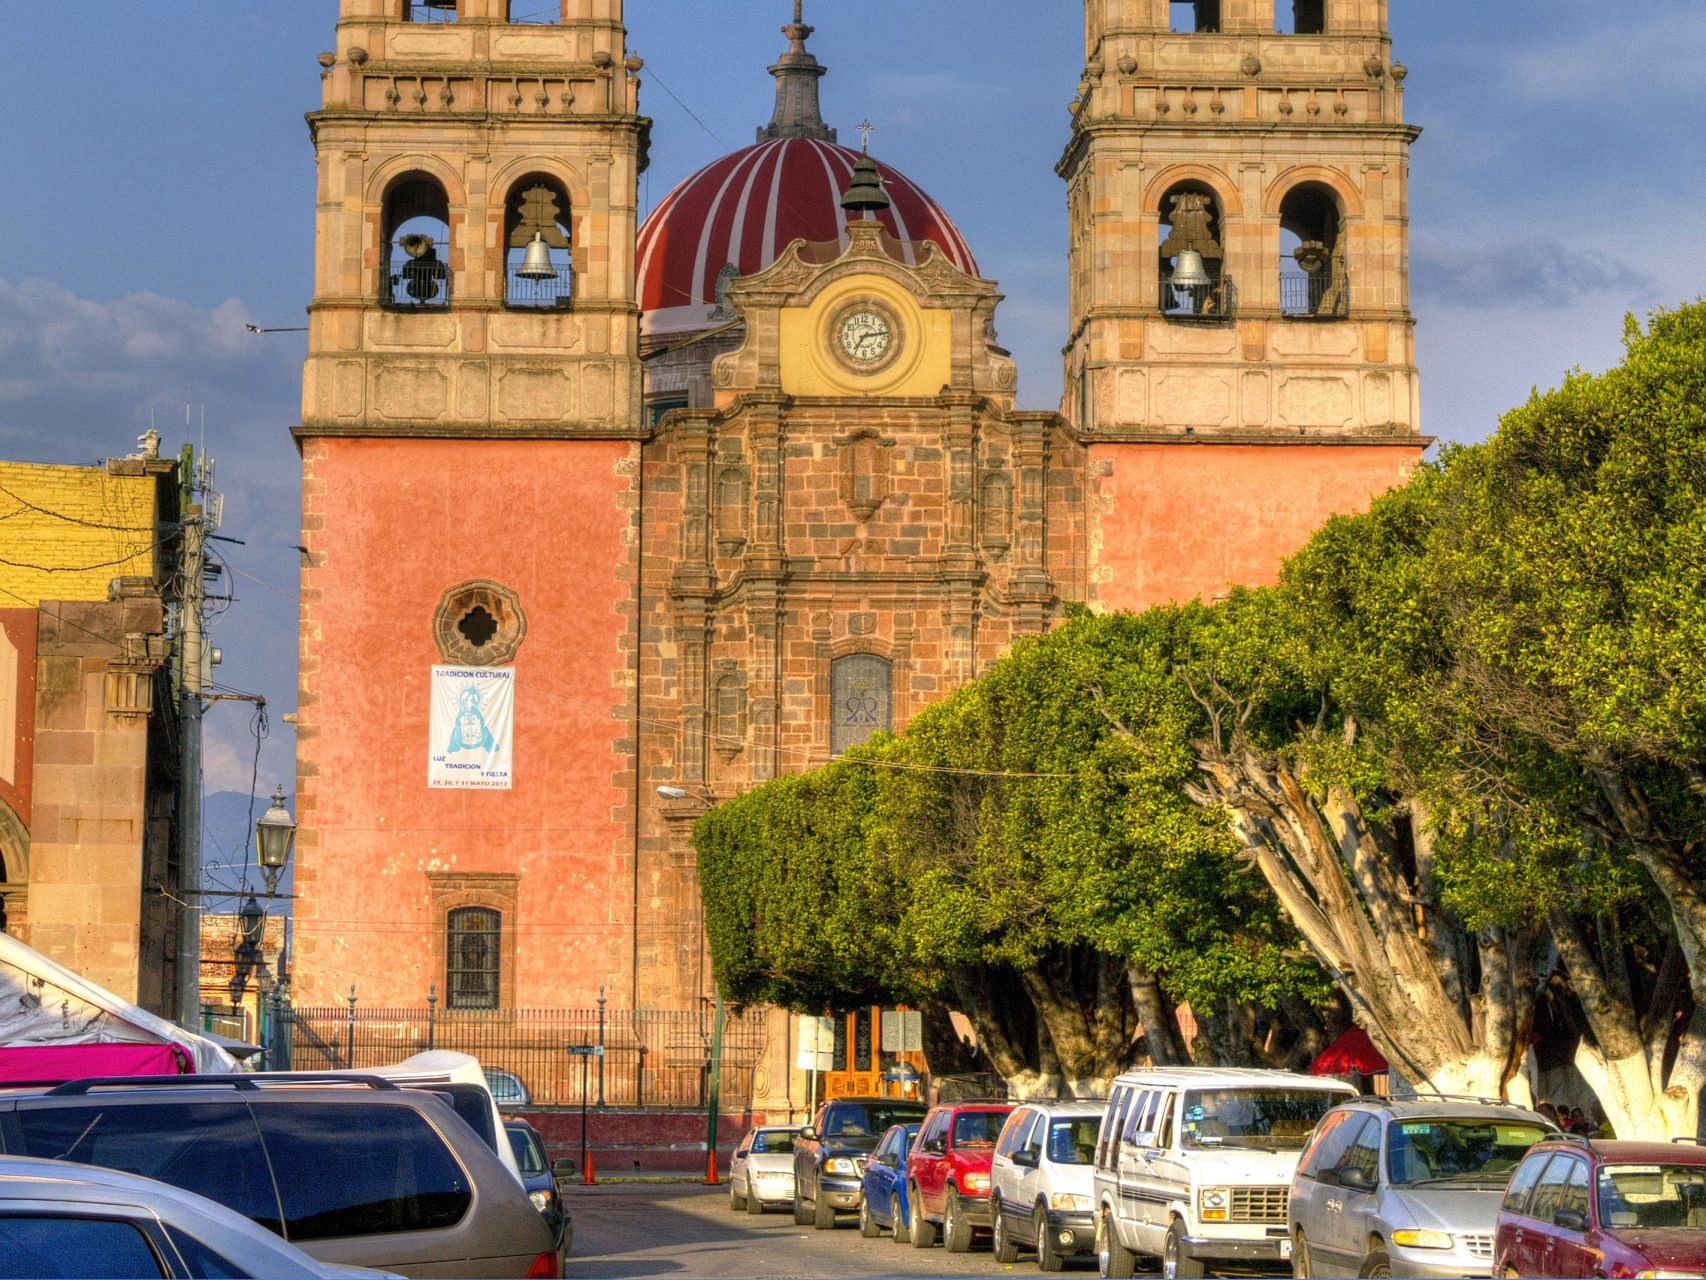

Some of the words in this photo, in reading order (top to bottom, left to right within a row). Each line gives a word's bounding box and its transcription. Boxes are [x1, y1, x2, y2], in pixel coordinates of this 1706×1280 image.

[861, 315, 868, 323] 12
[872, 317, 875, 325] 1
[847, 323, 854, 331] 10
[844, 332, 849, 340] 9
[862, 349, 867, 357] 6
[870, 347, 875, 355] 5
[436, 670, 474, 678] TRADICION
[475, 671, 510, 679] CULTURAL
